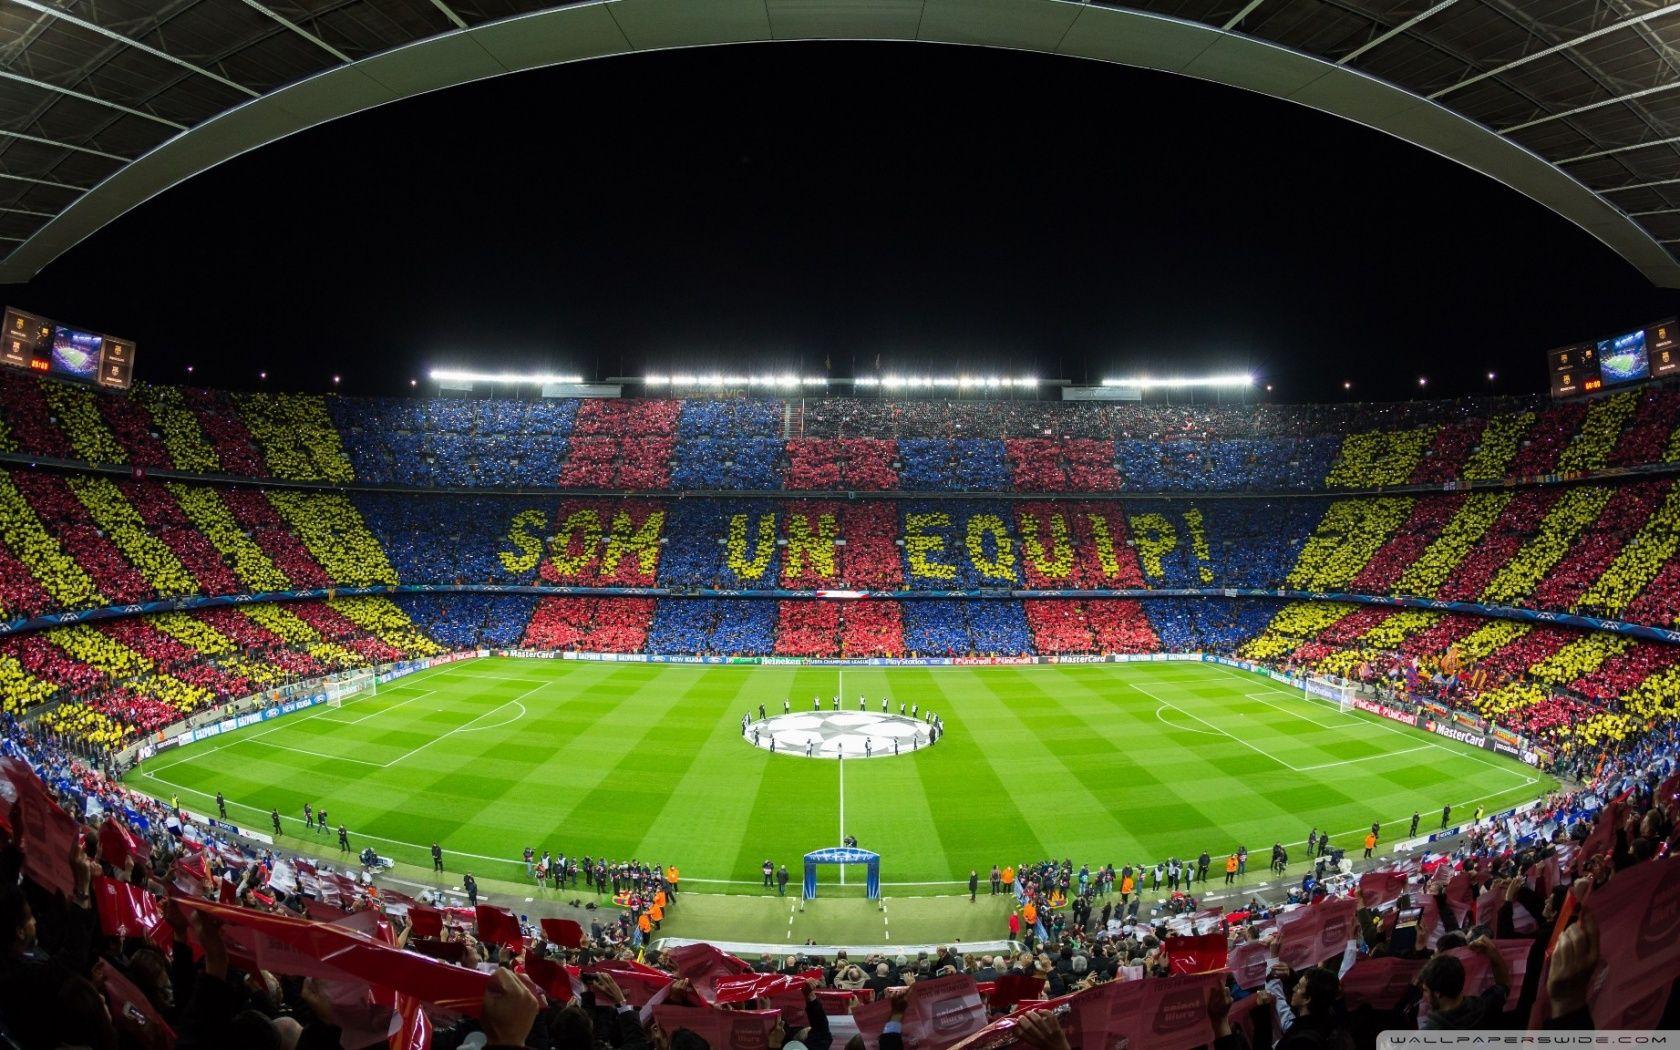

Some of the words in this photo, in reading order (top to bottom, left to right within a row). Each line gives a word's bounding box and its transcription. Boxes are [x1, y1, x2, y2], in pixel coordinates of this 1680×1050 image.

[499, 509, 664, 577] SOM
[727, 512, 836, 580] UN
[905, 508, 1213, 583] EQUIP!
[510, 650, 554, 659] MasterCard
[1060, 655, 1106, 663] MasterCard
[761, 657, 801, 665] Heineken
[1436, 724, 1485, 747] MasterCard
